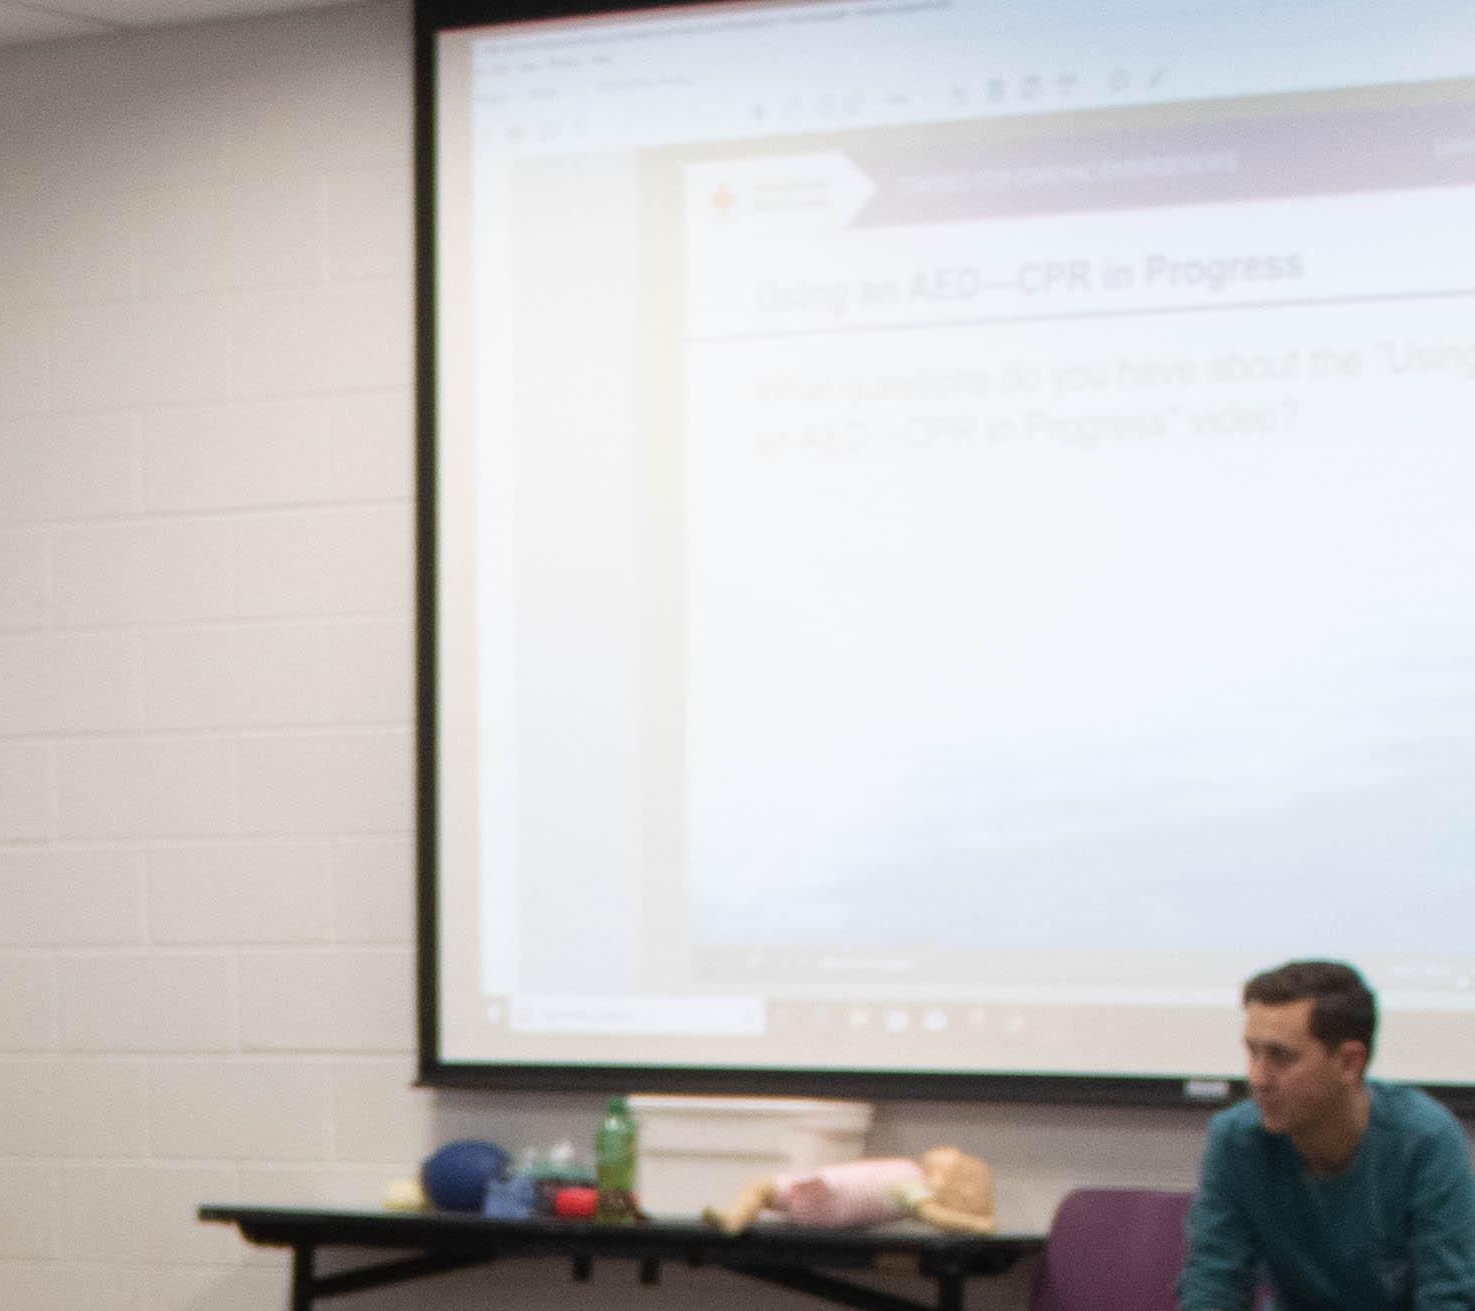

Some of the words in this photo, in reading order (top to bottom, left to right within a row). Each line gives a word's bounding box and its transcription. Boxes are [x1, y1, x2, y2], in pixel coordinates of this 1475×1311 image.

[755, 278, 849, 316] Using
[860, 279, 900, 305] an
[1102, 254, 1134, 289] in
[1145, 248, 1306, 293] Progress
[844, 369, 991, 406] questions
[1000, 362, 1042, 394] do
[1050, 364, 1108, 397] you
[1117, 354, 1197, 386] have
[1207, 348, 1299, 384] about
[1309, 345, 1363, 377] the
[756, 432, 792, 456] an
[988, 412, 1017, 444] in
[1192, 396, 1301, 434] video?
